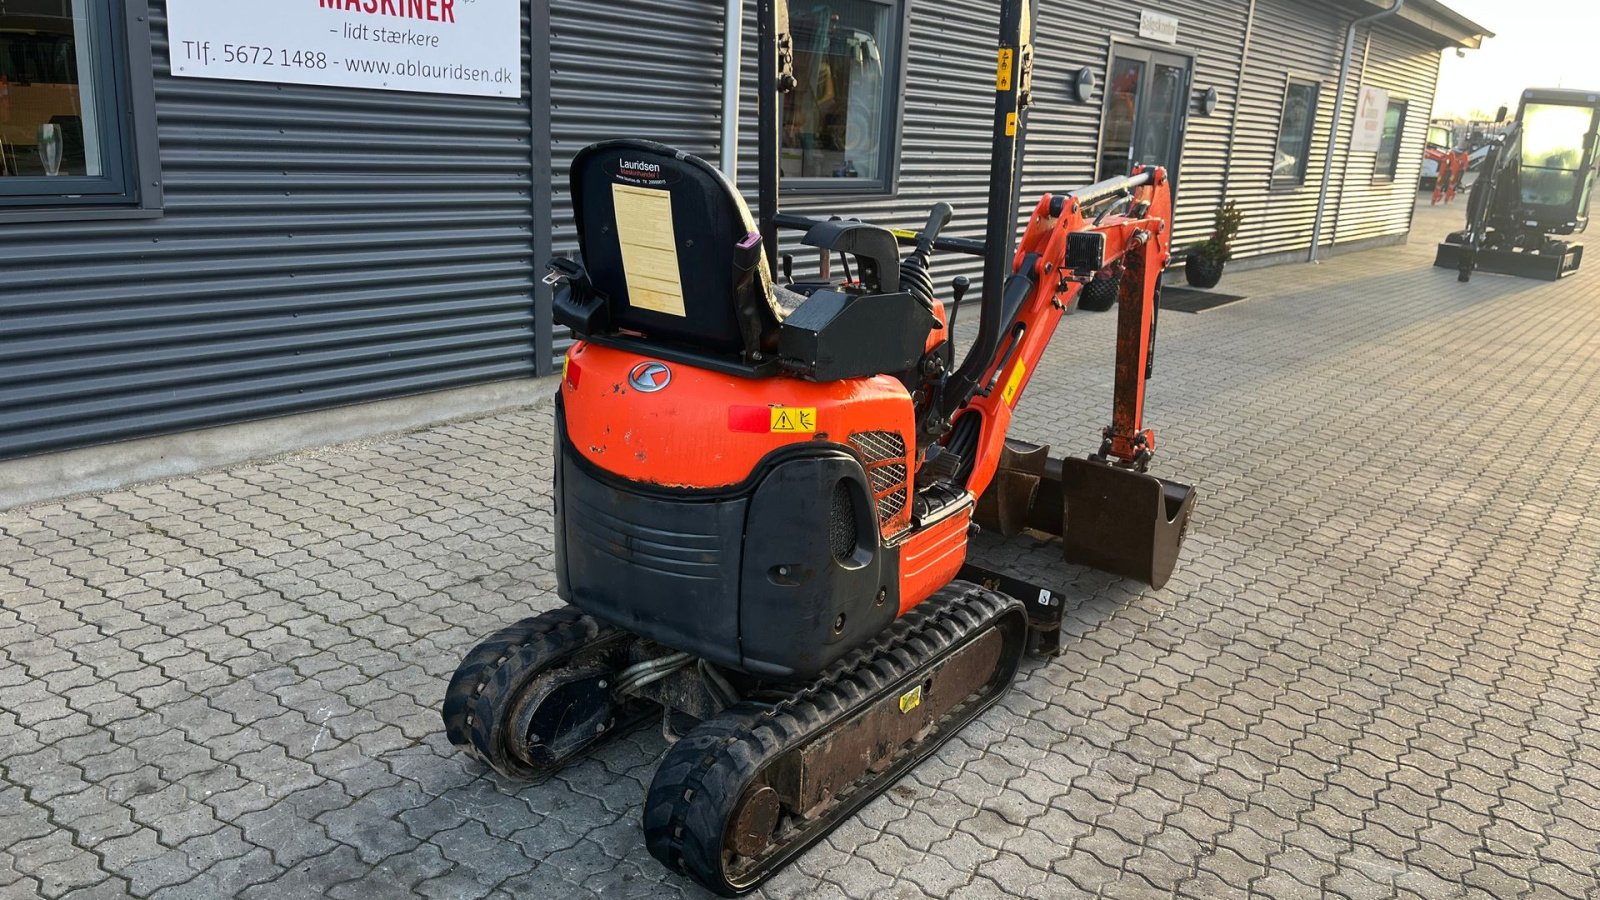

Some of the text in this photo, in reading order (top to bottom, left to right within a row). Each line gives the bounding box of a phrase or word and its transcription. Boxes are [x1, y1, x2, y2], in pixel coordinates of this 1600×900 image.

[319, 0, 455, 23] KINER
[343, 21, 368, 41] lidt
[373, 27, 439, 48] stærkere
[182, 40, 216, 66] Tlf.
[224, 44, 274, 66] 5672
[280, 49, 327, 70] 1488
[345, 58, 512, 84] www.ablauridsen.dk
[619, 157, 660, 172] Lauridsen
